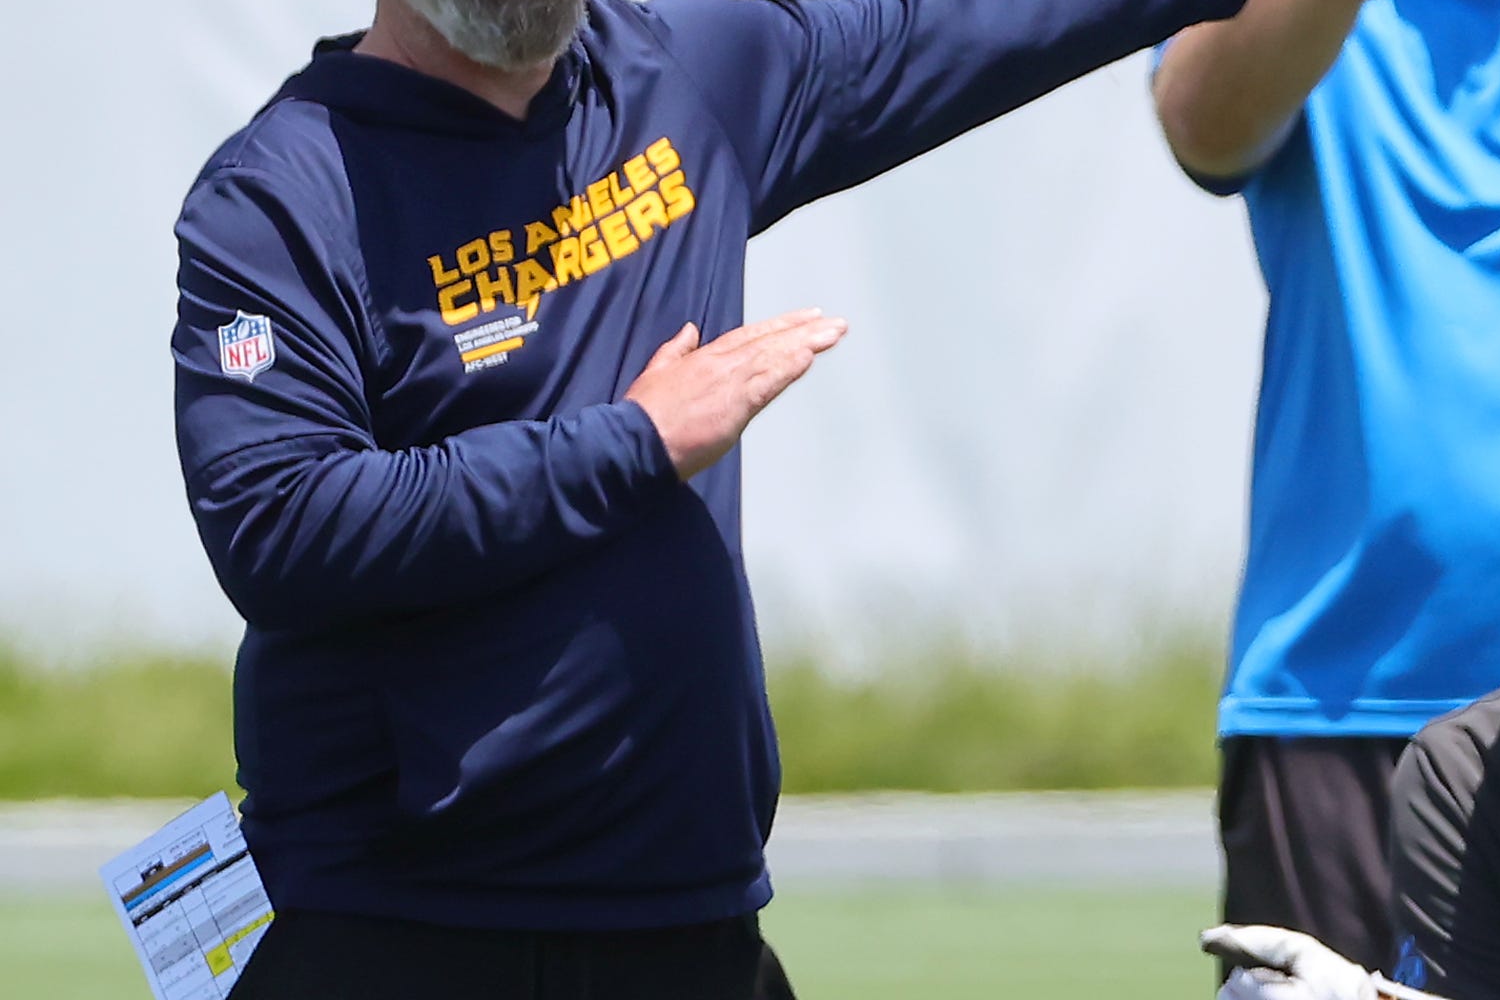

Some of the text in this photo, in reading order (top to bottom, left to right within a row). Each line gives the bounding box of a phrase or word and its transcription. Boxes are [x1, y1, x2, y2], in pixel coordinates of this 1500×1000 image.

[427, 136, 681, 287] LOS ANELES
[438, 169, 696, 325] CHARGERS
[228, 336, 268, 367] NFL
